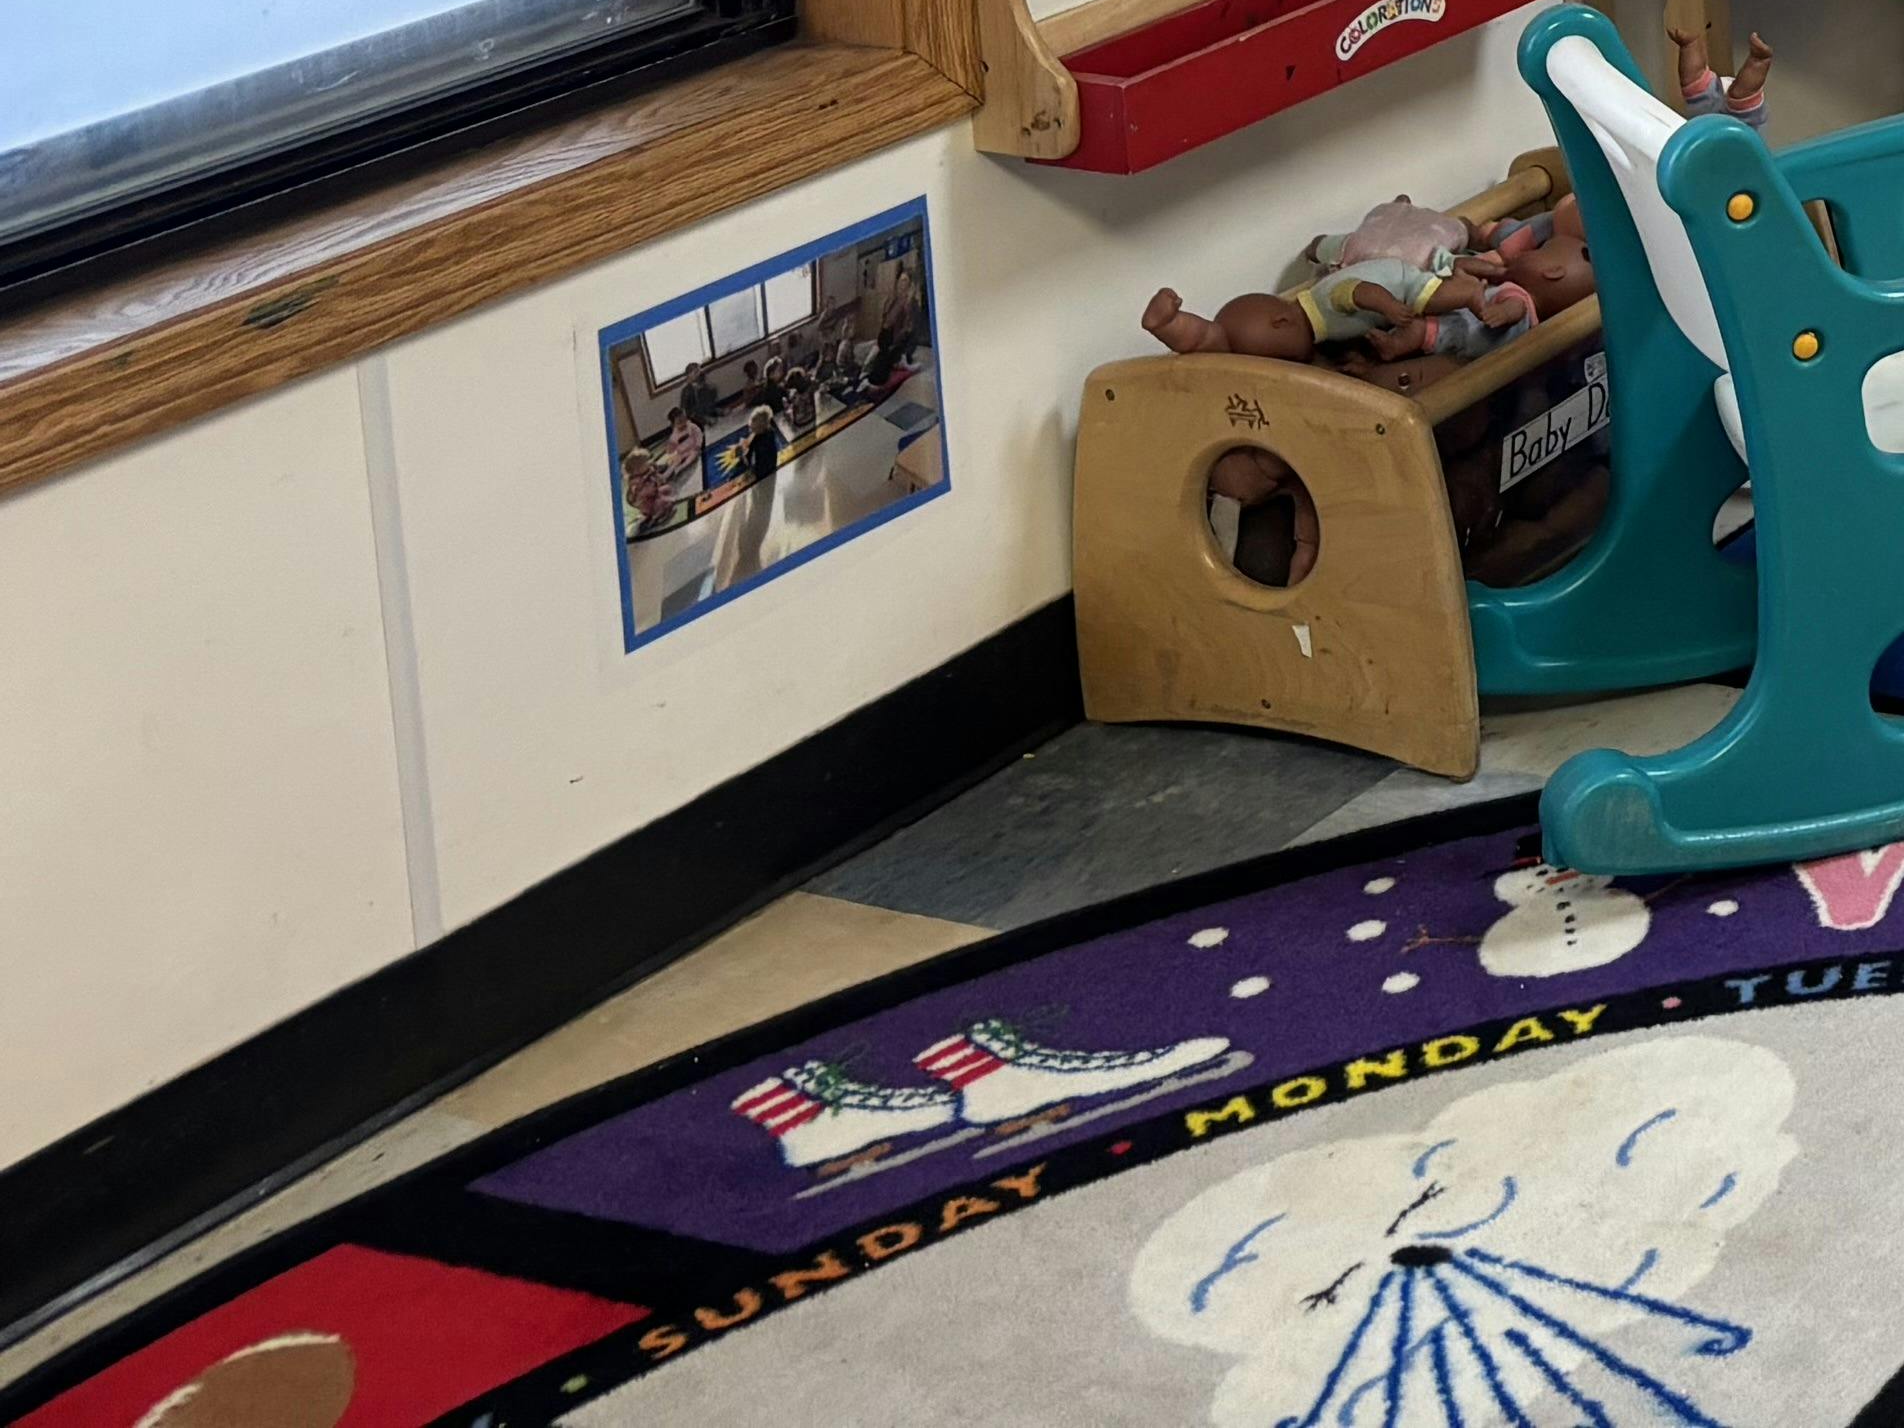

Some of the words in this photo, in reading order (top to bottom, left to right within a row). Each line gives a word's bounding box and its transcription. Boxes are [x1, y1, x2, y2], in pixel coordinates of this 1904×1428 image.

[1509, 411, 1573, 478] Baby
[1183, 1004, 1608, 1142] MONDAY
[640, 1159, 1052, 1365] SUNDAY
